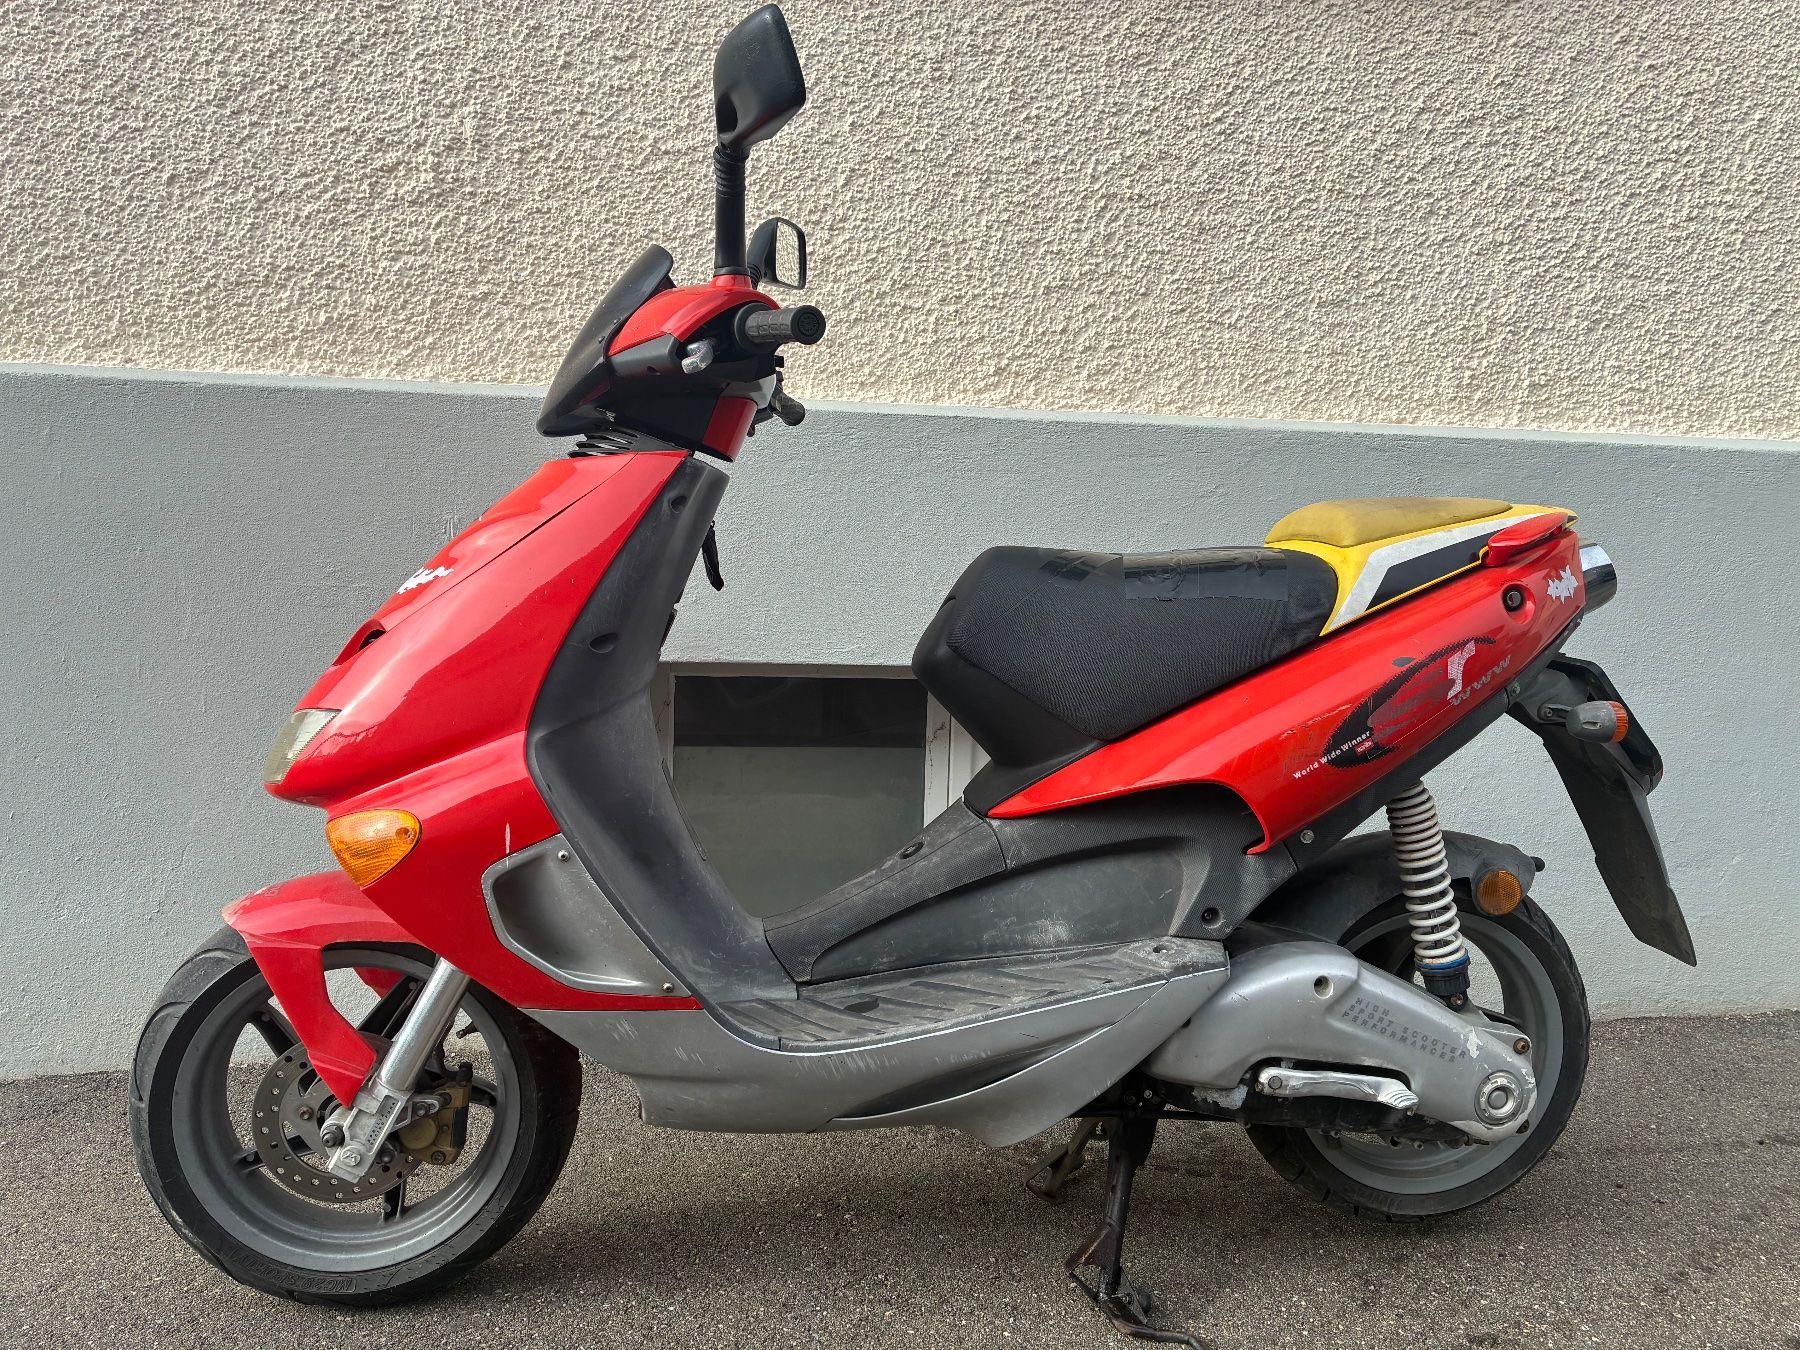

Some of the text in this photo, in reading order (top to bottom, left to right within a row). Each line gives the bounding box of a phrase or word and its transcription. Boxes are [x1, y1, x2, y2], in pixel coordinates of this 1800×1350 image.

[1293, 730, 1371, 780] World Wide Winner
[1349, 1005, 1467, 1059] SPORT SCOOTER
[1355, 997, 1390, 1018] HIGH
[1342, 1011, 1456, 1063] PERFORMANCES
